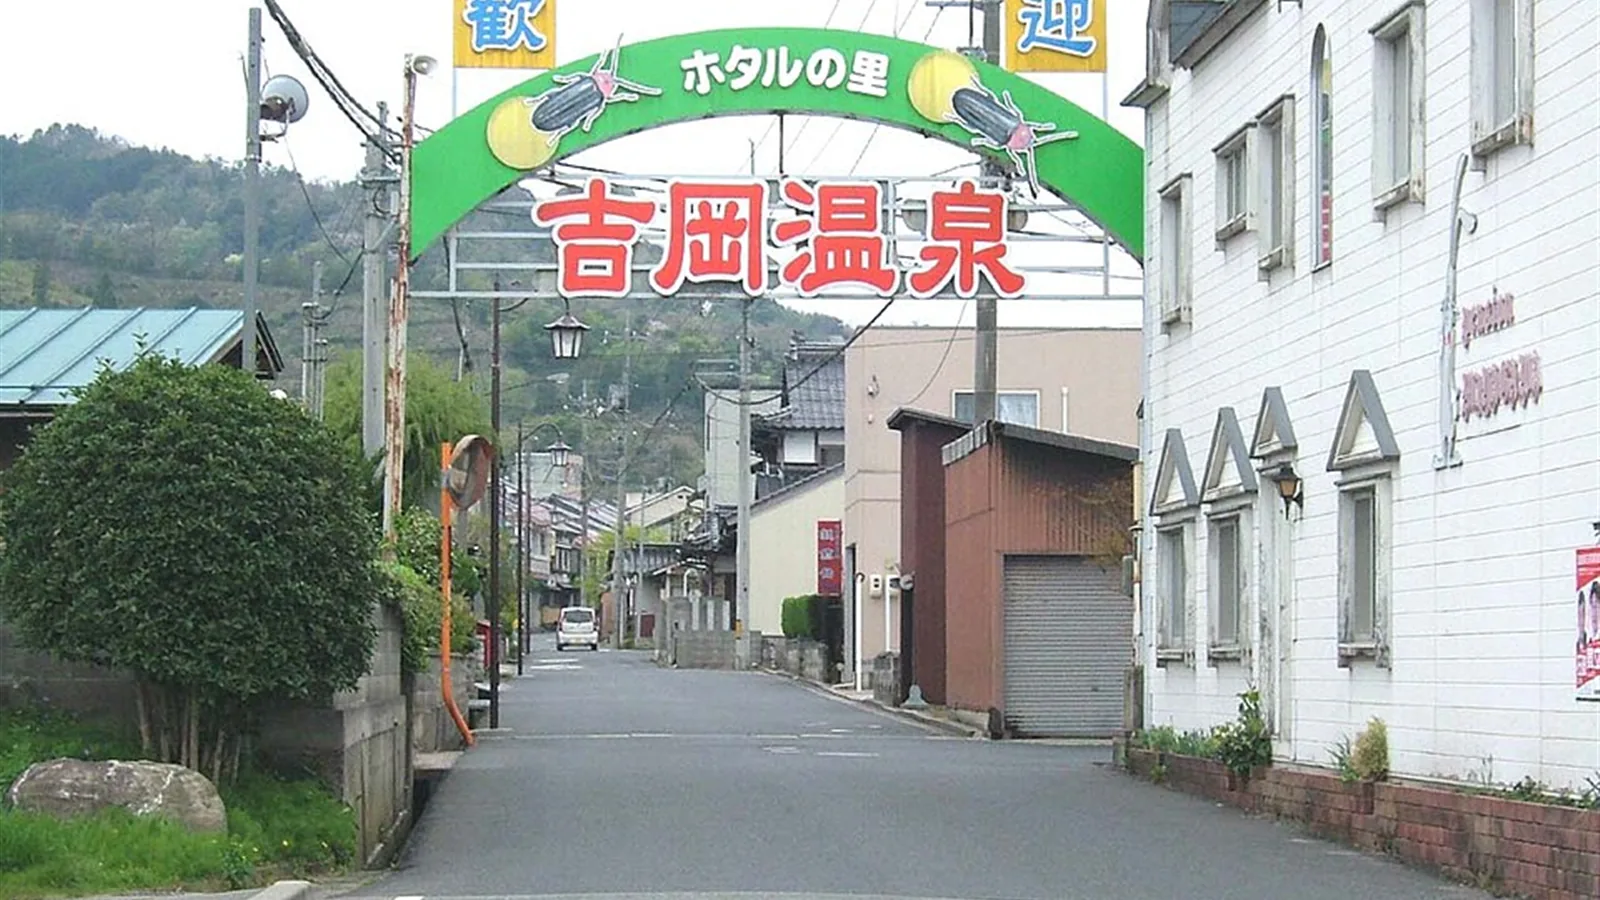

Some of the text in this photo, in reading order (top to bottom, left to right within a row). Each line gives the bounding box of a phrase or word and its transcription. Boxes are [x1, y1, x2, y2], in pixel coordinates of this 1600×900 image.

[1018, 0, 1097, 56] 迎
[680, 44, 889, 97] ホタルの里
[533, 178, 1026, 297] 吉岡温泉
